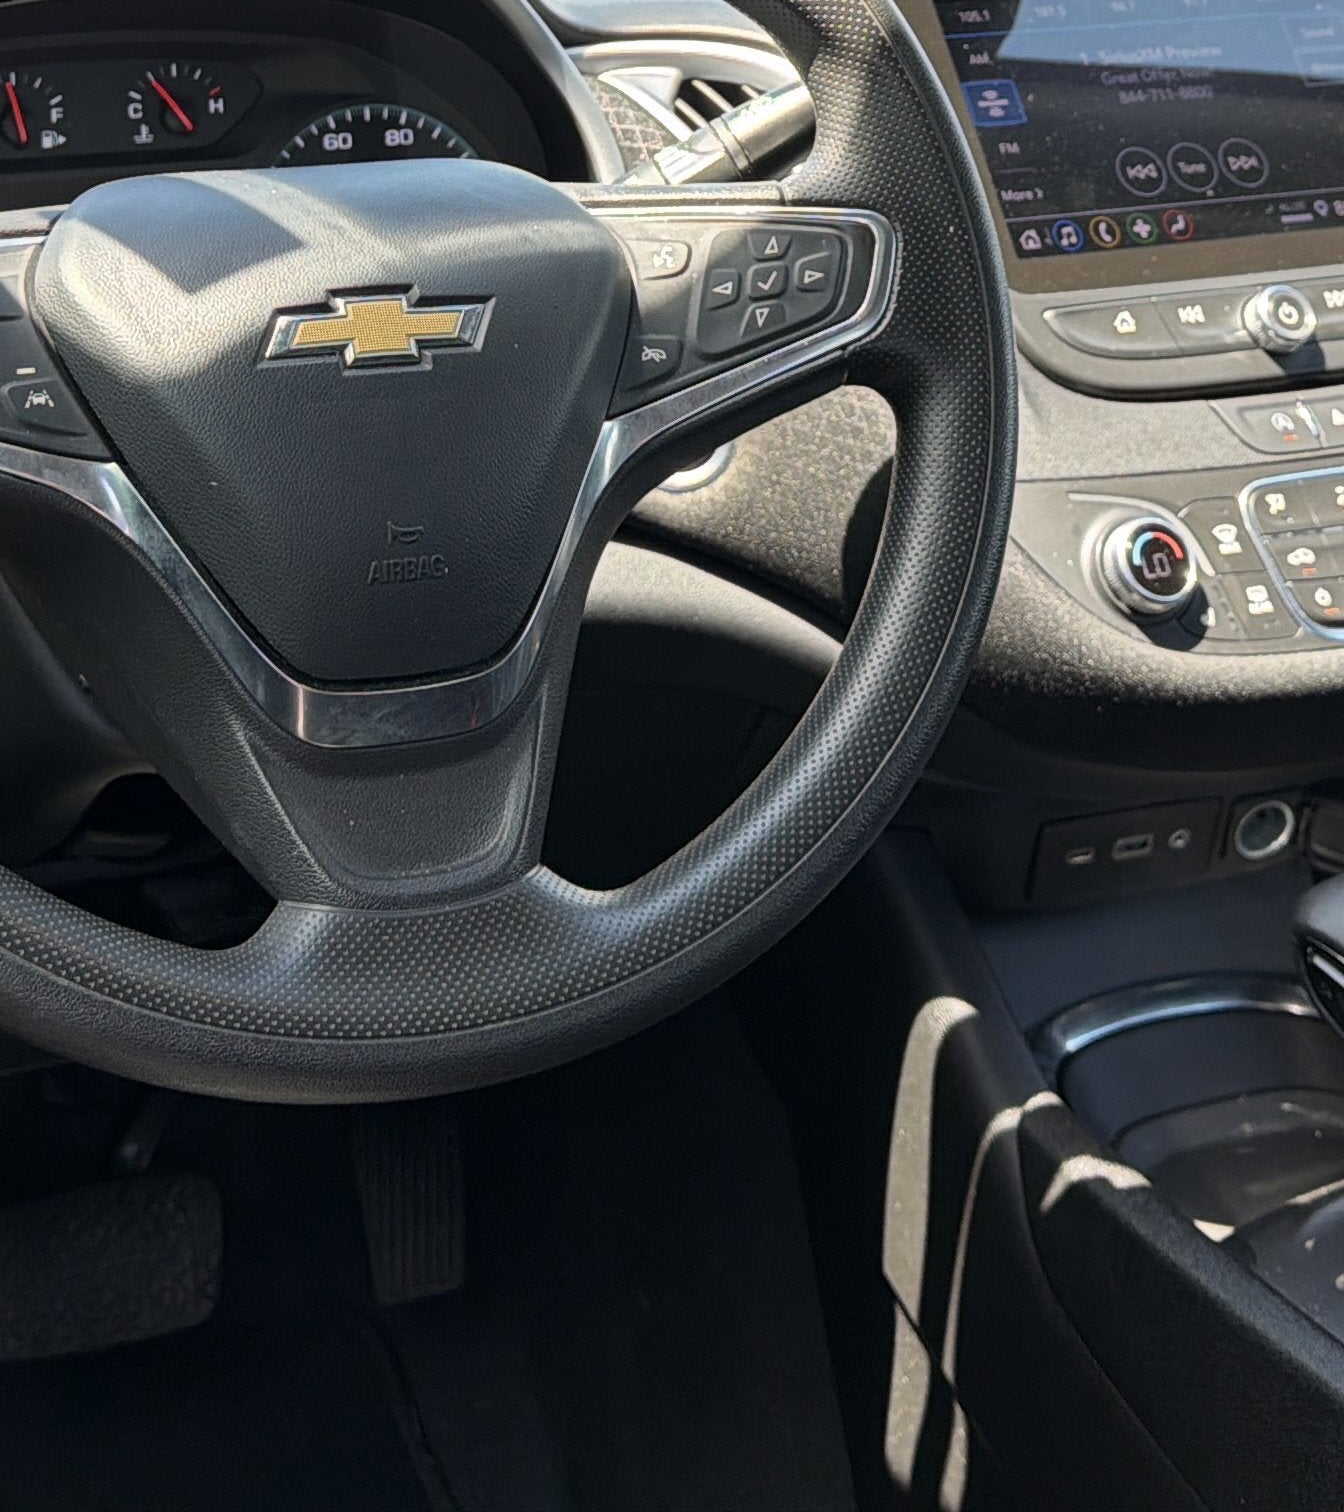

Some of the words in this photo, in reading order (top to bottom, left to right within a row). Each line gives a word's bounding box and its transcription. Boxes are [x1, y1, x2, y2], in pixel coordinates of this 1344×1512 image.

[49, 107, 64, 125] F
[127, 102, 144, 120] C
[208, 97, 225, 115] H
[322, 131, 353, 152] 60
[384, 128, 415, 148] 80
[998, 141, 1020, 155] FM
[1176, 160, 1206, 175] Tune
[367, 554, 445, 585] AIRBAG
